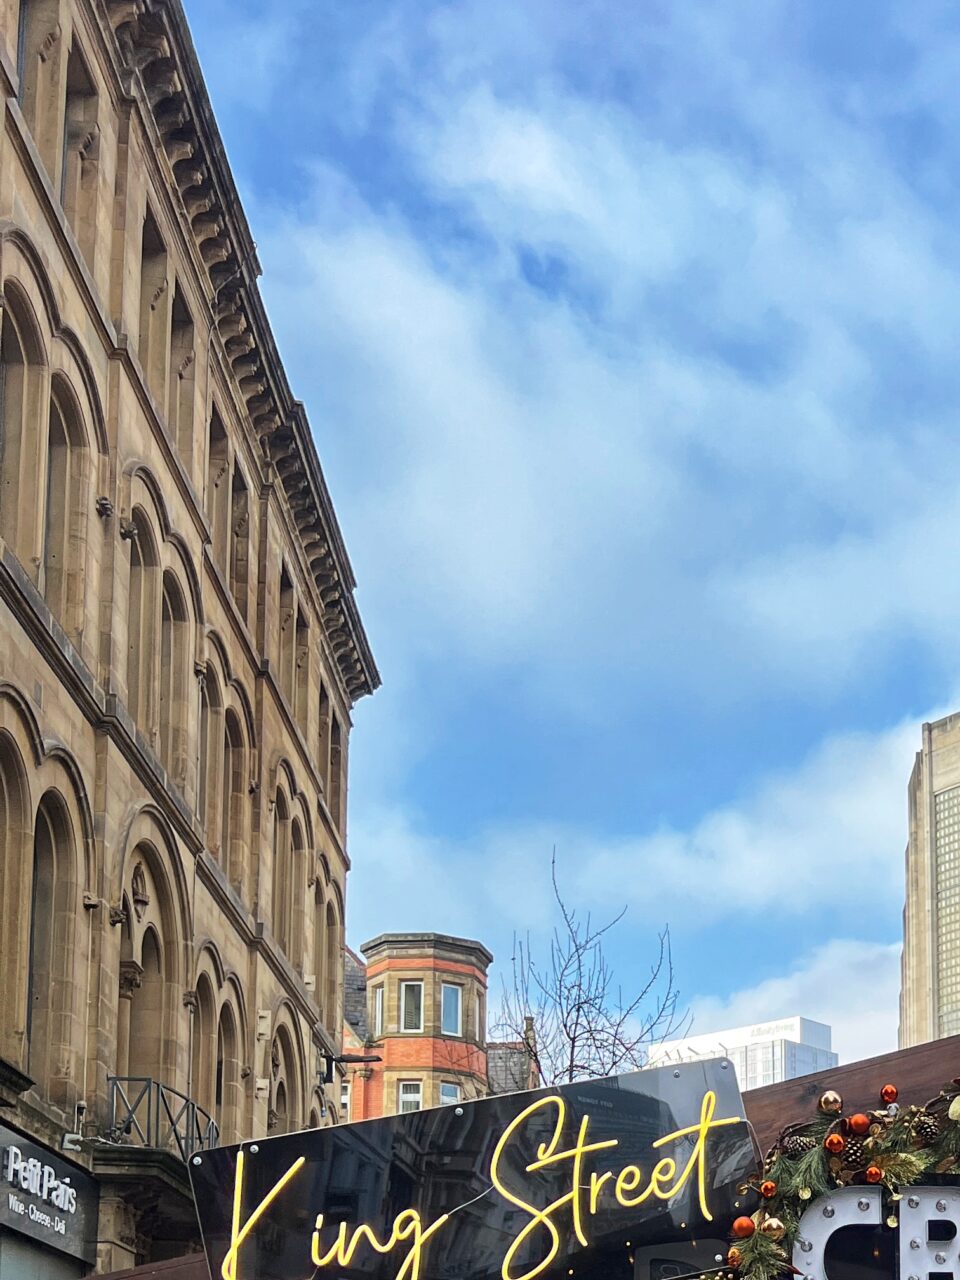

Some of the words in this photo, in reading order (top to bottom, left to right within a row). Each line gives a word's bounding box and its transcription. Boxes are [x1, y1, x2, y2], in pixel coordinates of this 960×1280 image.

[8, 1145, 42, 1197] Petit
[42, 1165, 77, 1214] Paris
[8, 1193, 25, 1215] Wine
[28, 1204, 51, 1228] Cheese
[54, 1216, 66, 1235] Deli
